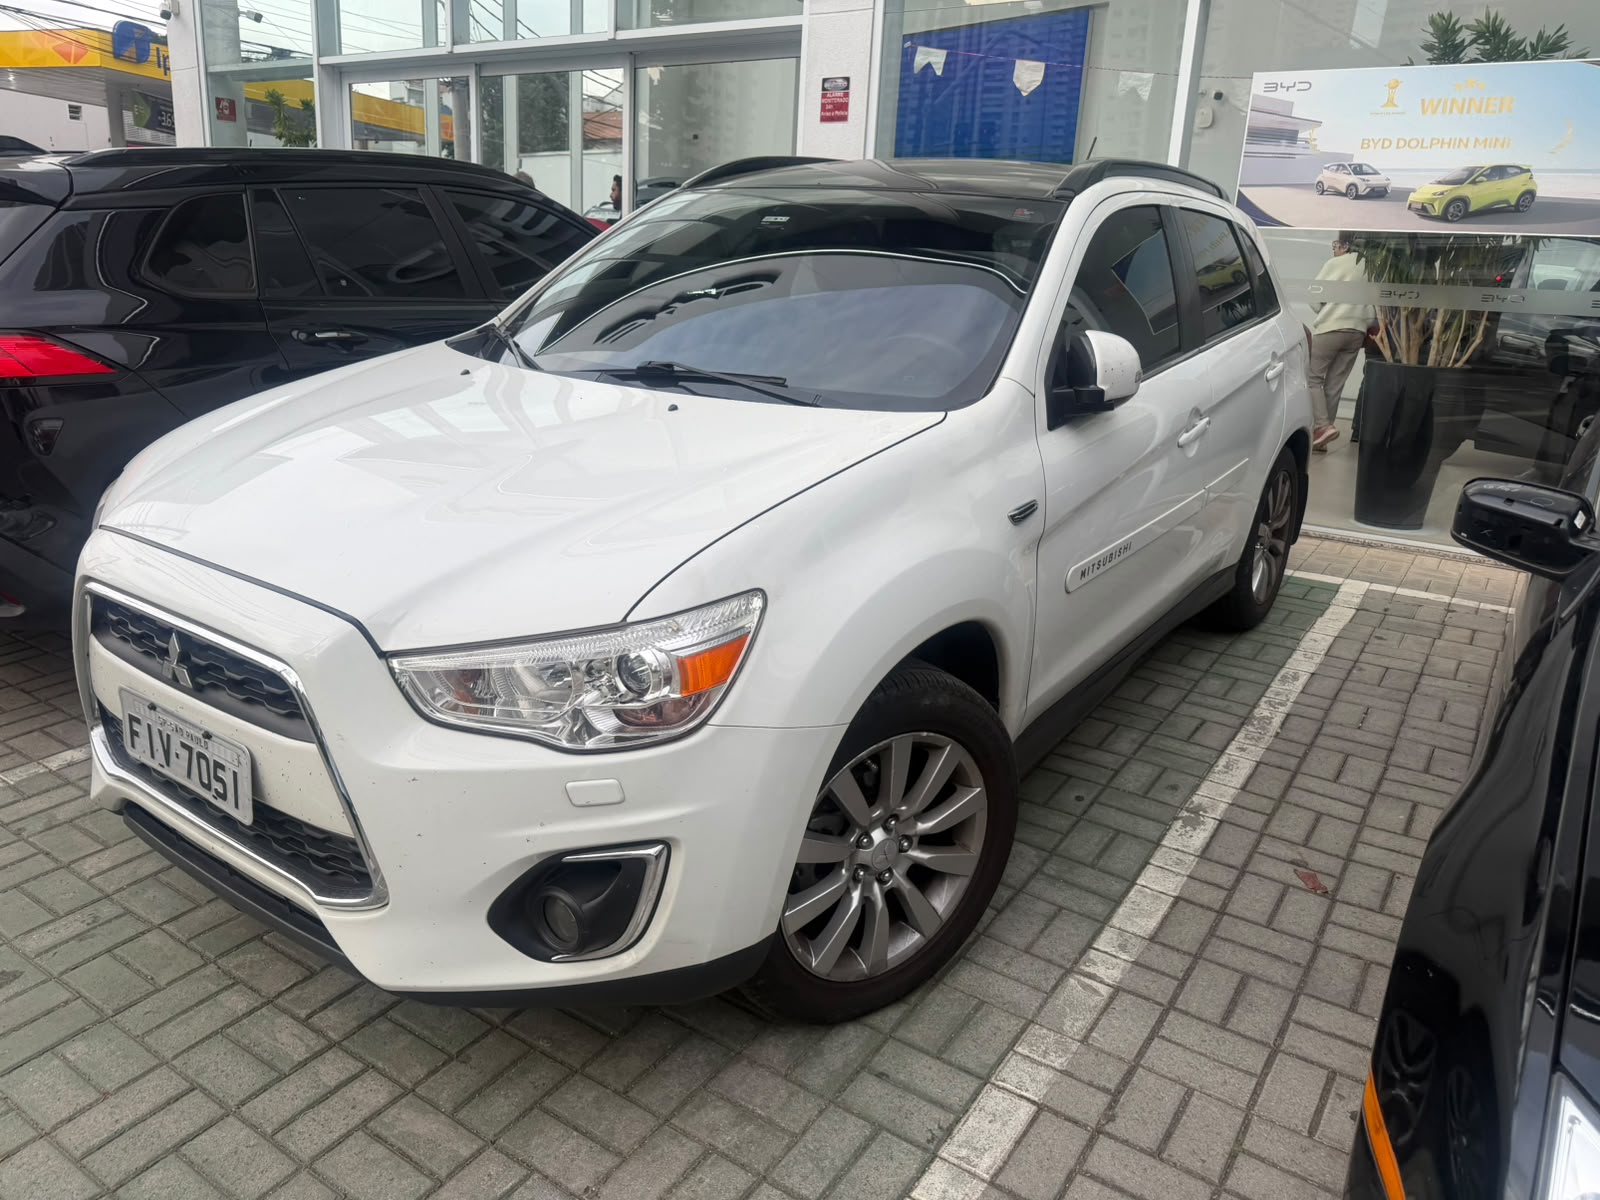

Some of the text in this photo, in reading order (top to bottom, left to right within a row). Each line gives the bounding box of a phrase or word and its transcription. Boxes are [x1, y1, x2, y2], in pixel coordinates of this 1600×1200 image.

[1263, 81, 1312, 92] BYD
[1420, 96, 1514, 116] WINNER
[1360, 137, 1512, 150] BYD DOLPHIN MINI
[1380, 290, 1420, 299] BYD
[1481, 294, 1525, 303] BYD
[1080, 541, 1132, 580] MITSUBISHI
